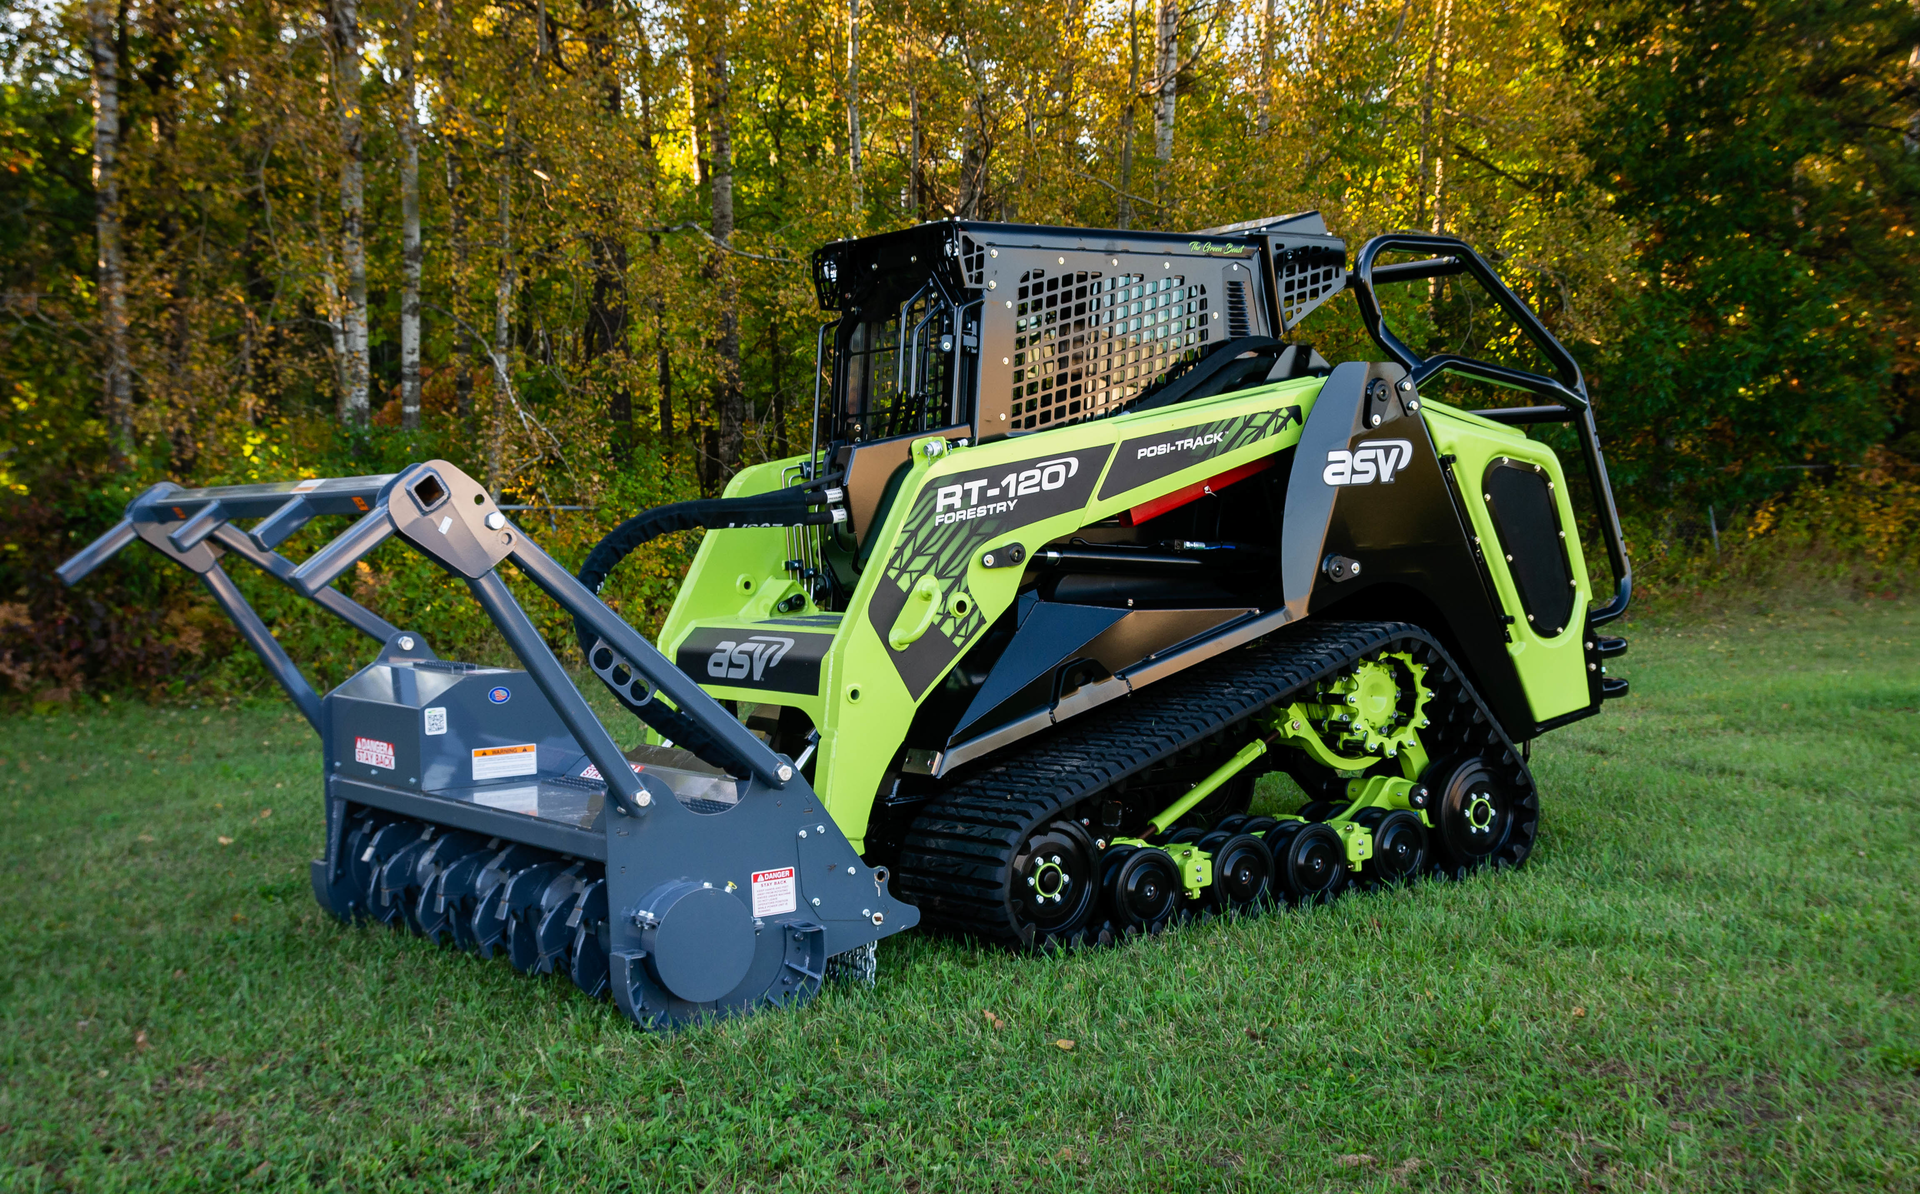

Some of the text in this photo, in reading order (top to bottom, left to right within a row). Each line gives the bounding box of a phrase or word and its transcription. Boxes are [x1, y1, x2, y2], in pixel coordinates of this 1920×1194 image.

[1188, 241, 1201, 252] The
[1203, 242, 1222, 253] Green
[1137, 431, 1224, 460] POSI-TRACK
[935, 464, 1067, 513] RT-120
[934, 498, 1019, 527] FORESTRY
[361, 738, 388, 753] DANGER
[491, 747, 518, 756] WARNING
[357, 750, 393, 767] STAY BACK
[765, 871, 789, 880] DANGER
